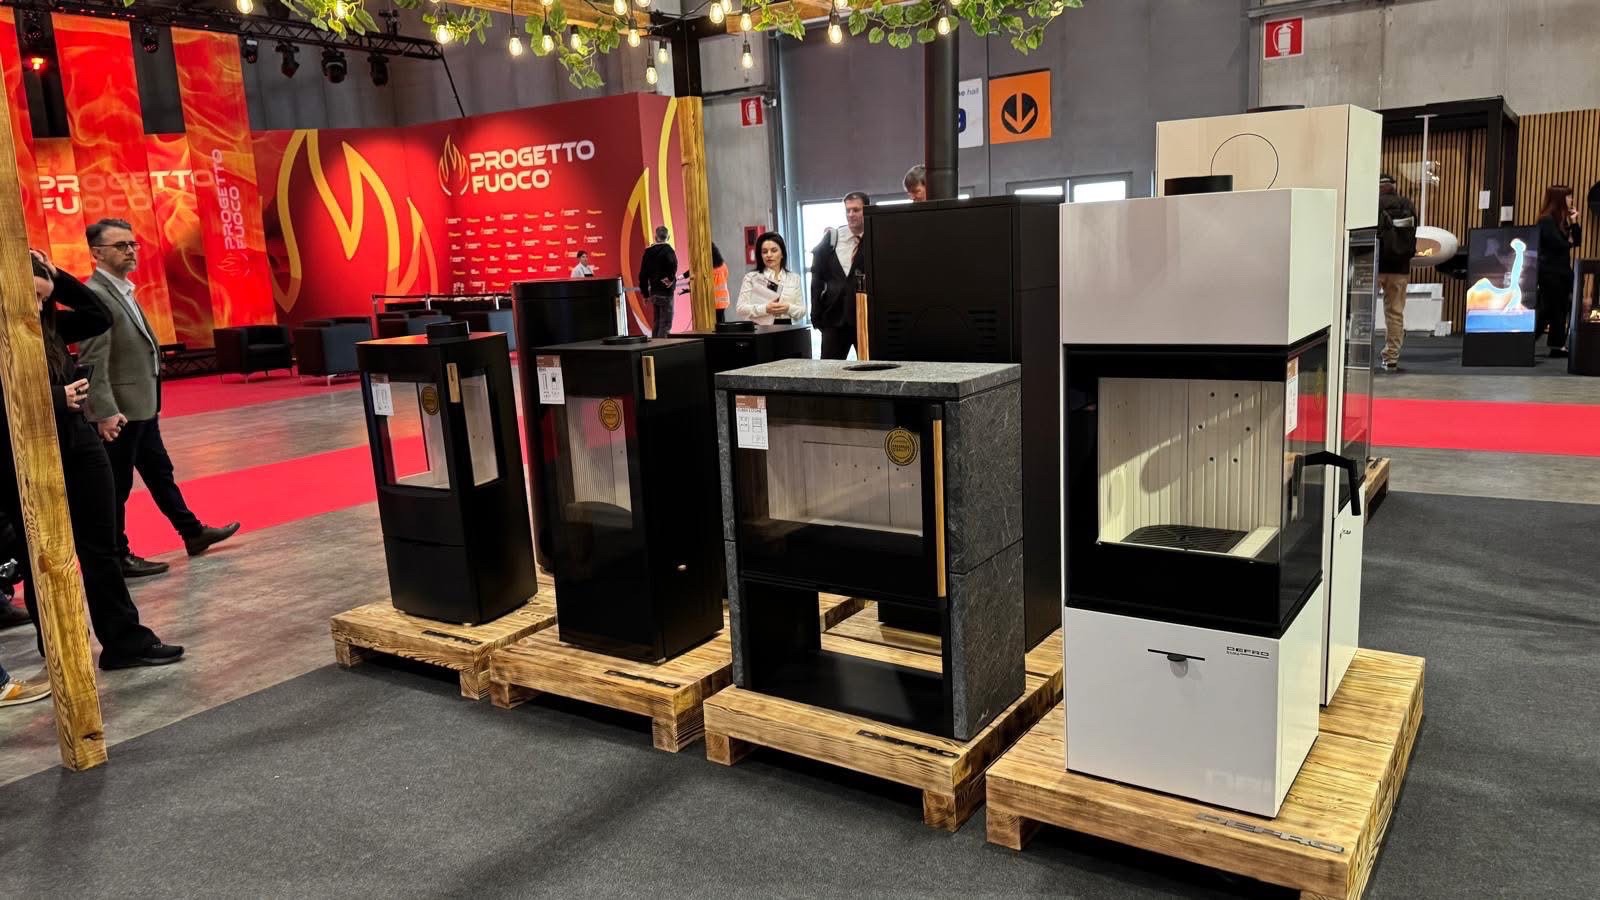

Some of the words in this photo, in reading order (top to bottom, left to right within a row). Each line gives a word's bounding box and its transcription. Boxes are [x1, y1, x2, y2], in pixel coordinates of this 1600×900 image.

[967, 88, 979, 96] hall
[469, 139, 595, 173] PROGETTO
[36, 169, 213, 193] PROGETTO
[472, 169, 549, 194] FUOCO
[37, 193, 151, 215] FUOCO
[212, 149, 236, 249] PROGETTO
[229, 186, 247, 249] FUOCO
[1226, 646, 1269, 656] DEFRO
